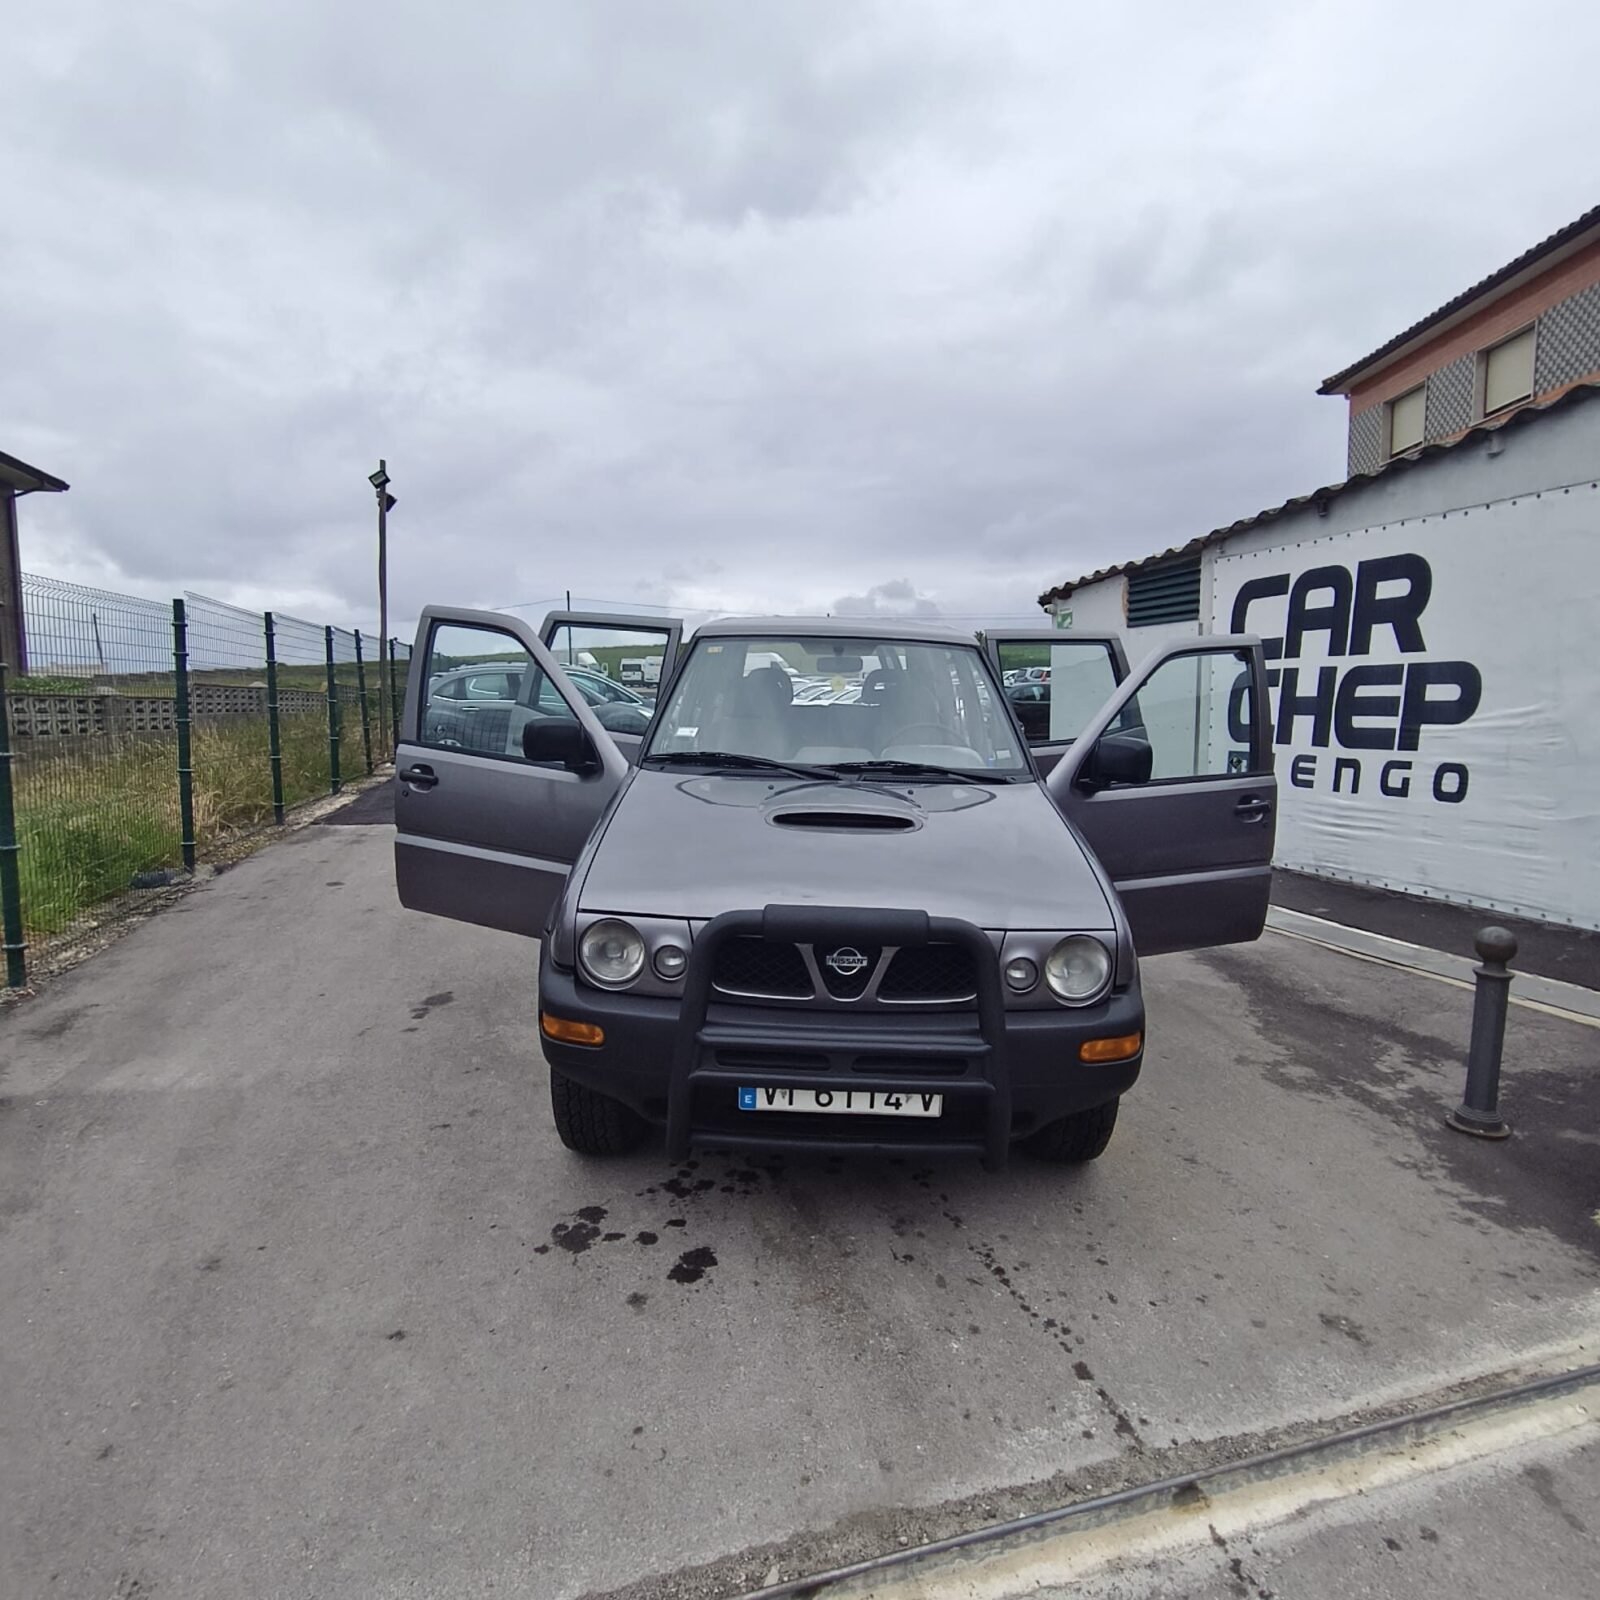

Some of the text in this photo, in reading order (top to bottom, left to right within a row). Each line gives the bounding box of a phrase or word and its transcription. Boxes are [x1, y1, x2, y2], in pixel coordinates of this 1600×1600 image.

[1230, 553, 1432, 660] CAR
[1227, 661, 1482, 751] CHEP
[830, 957, 864, 965] NISSAN
[744, 1094, 752, 1104] E
